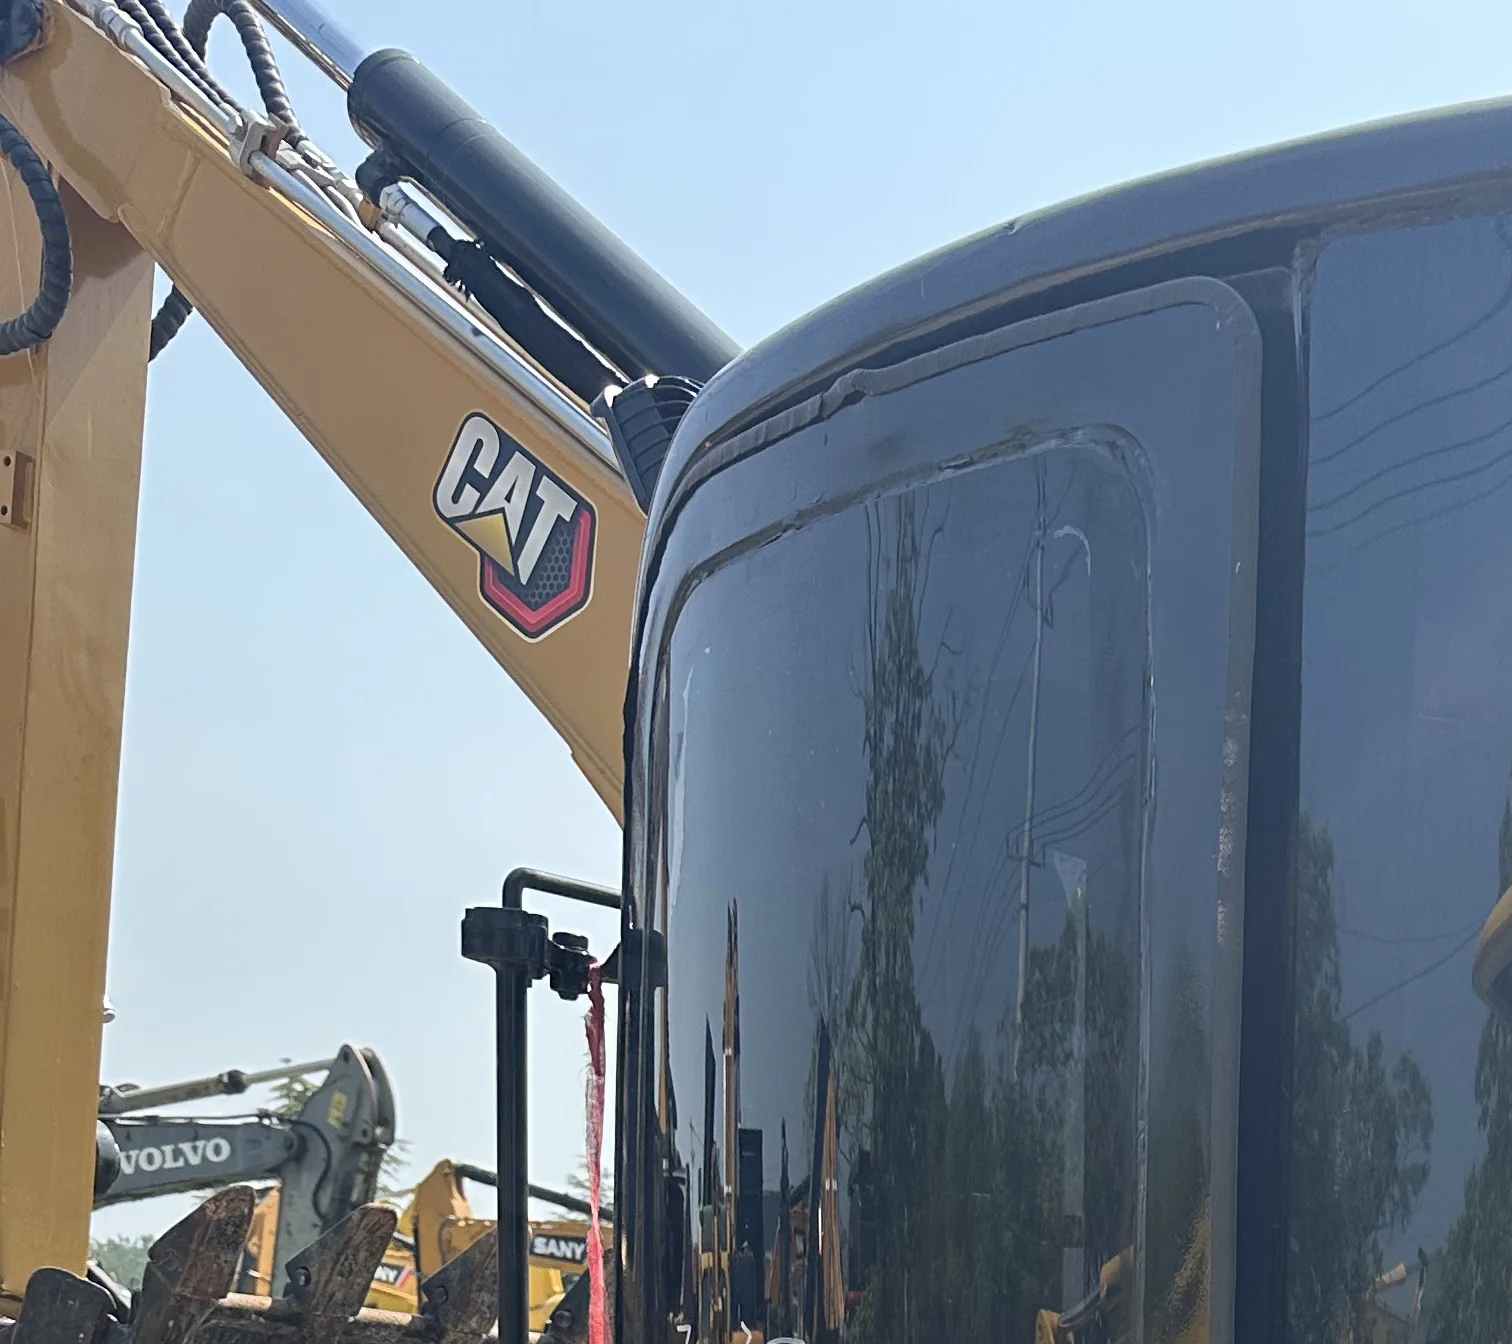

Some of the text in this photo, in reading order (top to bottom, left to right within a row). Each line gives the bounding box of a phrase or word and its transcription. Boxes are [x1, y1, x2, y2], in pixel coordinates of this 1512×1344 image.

[436, 415, 578, 586] CAT
[119, 1138, 231, 1175] VOLVO
[533, 1236, 585, 1260] SANY
